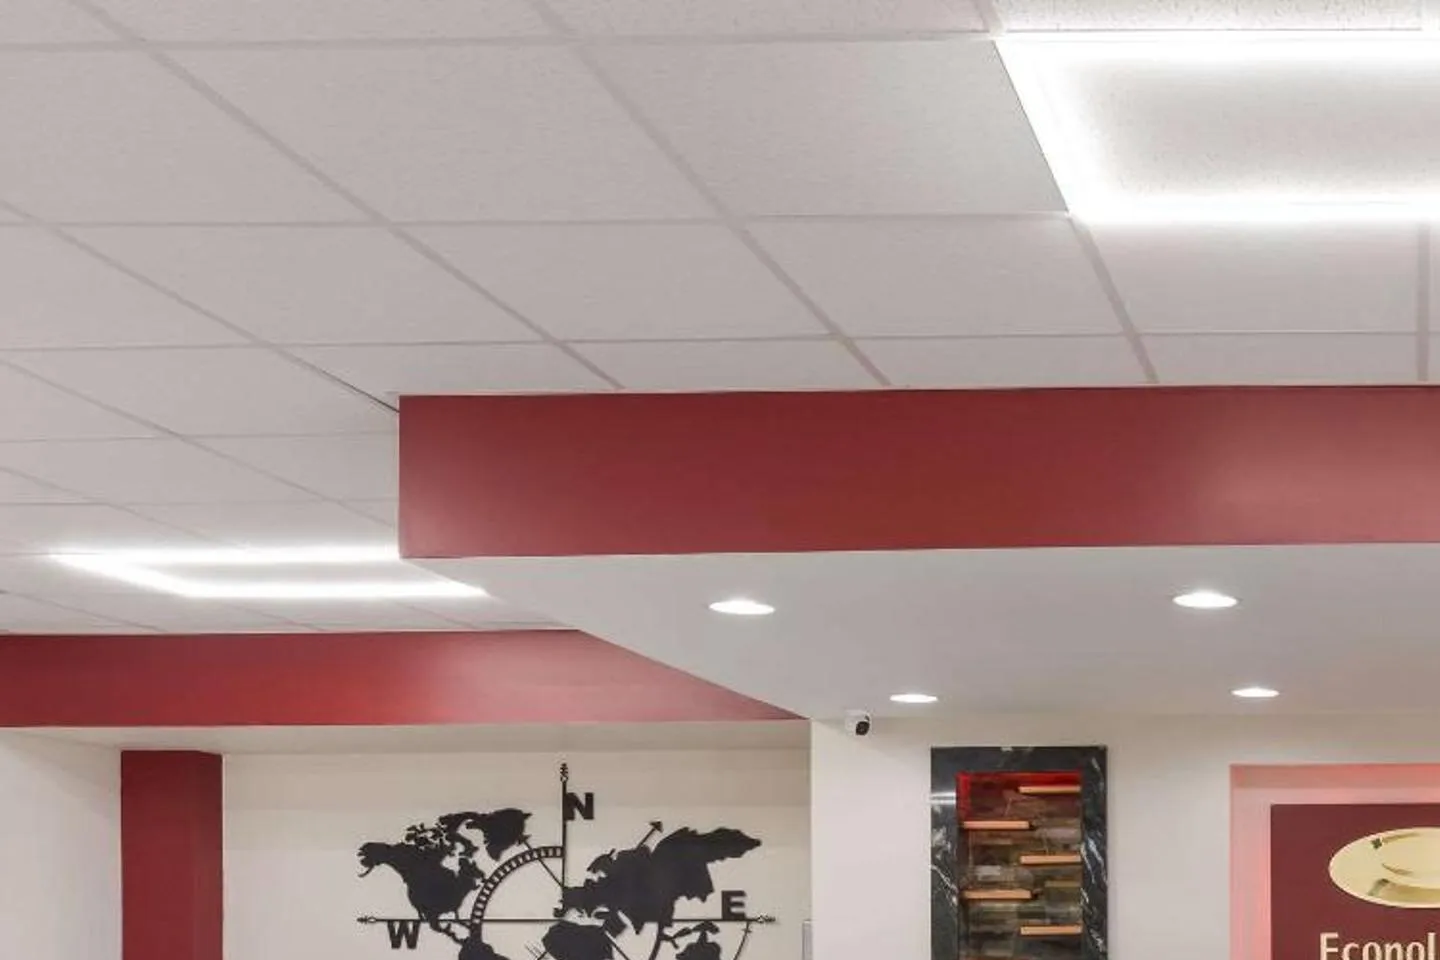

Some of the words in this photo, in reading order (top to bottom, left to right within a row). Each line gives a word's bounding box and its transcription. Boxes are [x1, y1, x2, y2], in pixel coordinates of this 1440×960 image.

[564, 792, 595, 821] N
[721, 890, 747, 920] E
[388, 920, 421, 949] W
